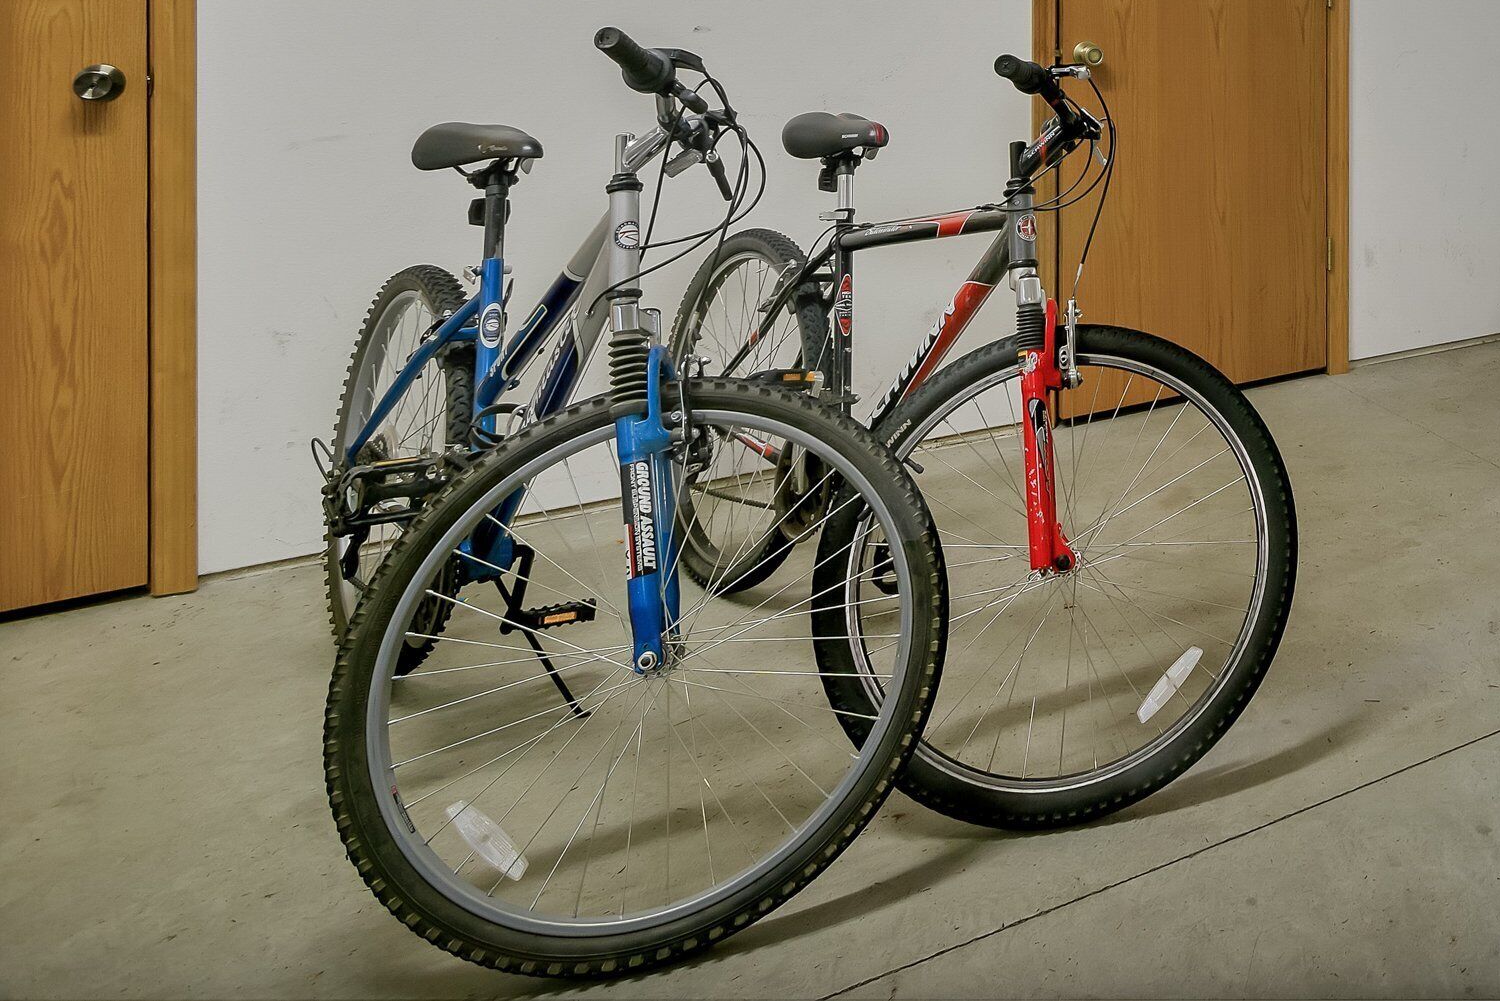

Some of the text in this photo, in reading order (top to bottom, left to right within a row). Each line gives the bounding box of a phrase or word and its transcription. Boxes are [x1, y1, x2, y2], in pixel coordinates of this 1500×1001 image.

[1027, 130, 1056, 159] SCHWINN
[885, 418, 913, 449] WINN
[635, 461, 657, 570] GROUND ASSAULT
